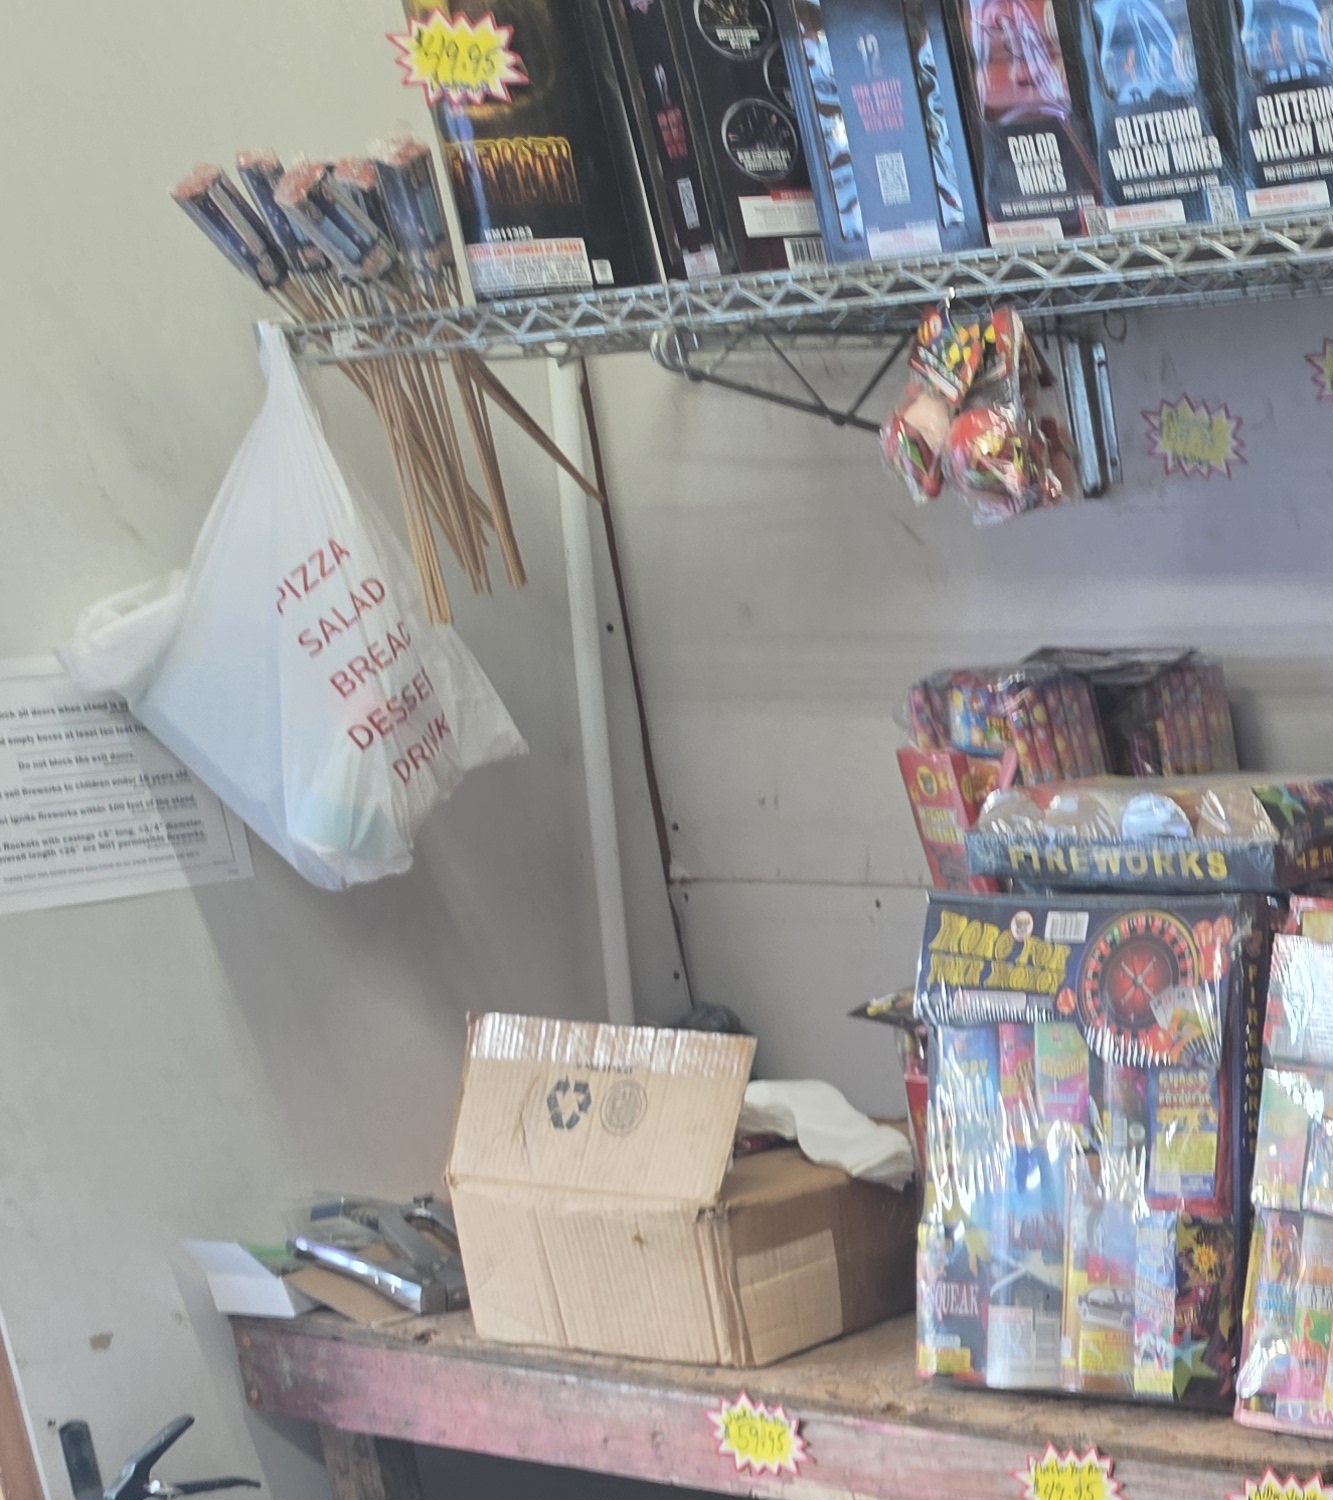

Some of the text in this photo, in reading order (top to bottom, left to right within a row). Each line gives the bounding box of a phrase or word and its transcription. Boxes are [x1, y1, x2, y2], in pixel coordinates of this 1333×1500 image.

[1008, 132, 1062, 164] COLOR
[1107, 143, 1171, 181] WILLOW
[1171, 136, 1223, 173] MINES
[1249, 121, 1316, 163] WILLOW
[1015, 164, 1067, 195] MINES
[297, 577, 386, 658] SALAD
[391, 710, 452, 785] DRINK
[1008, 842, 1229, 880] FIREWORKS
